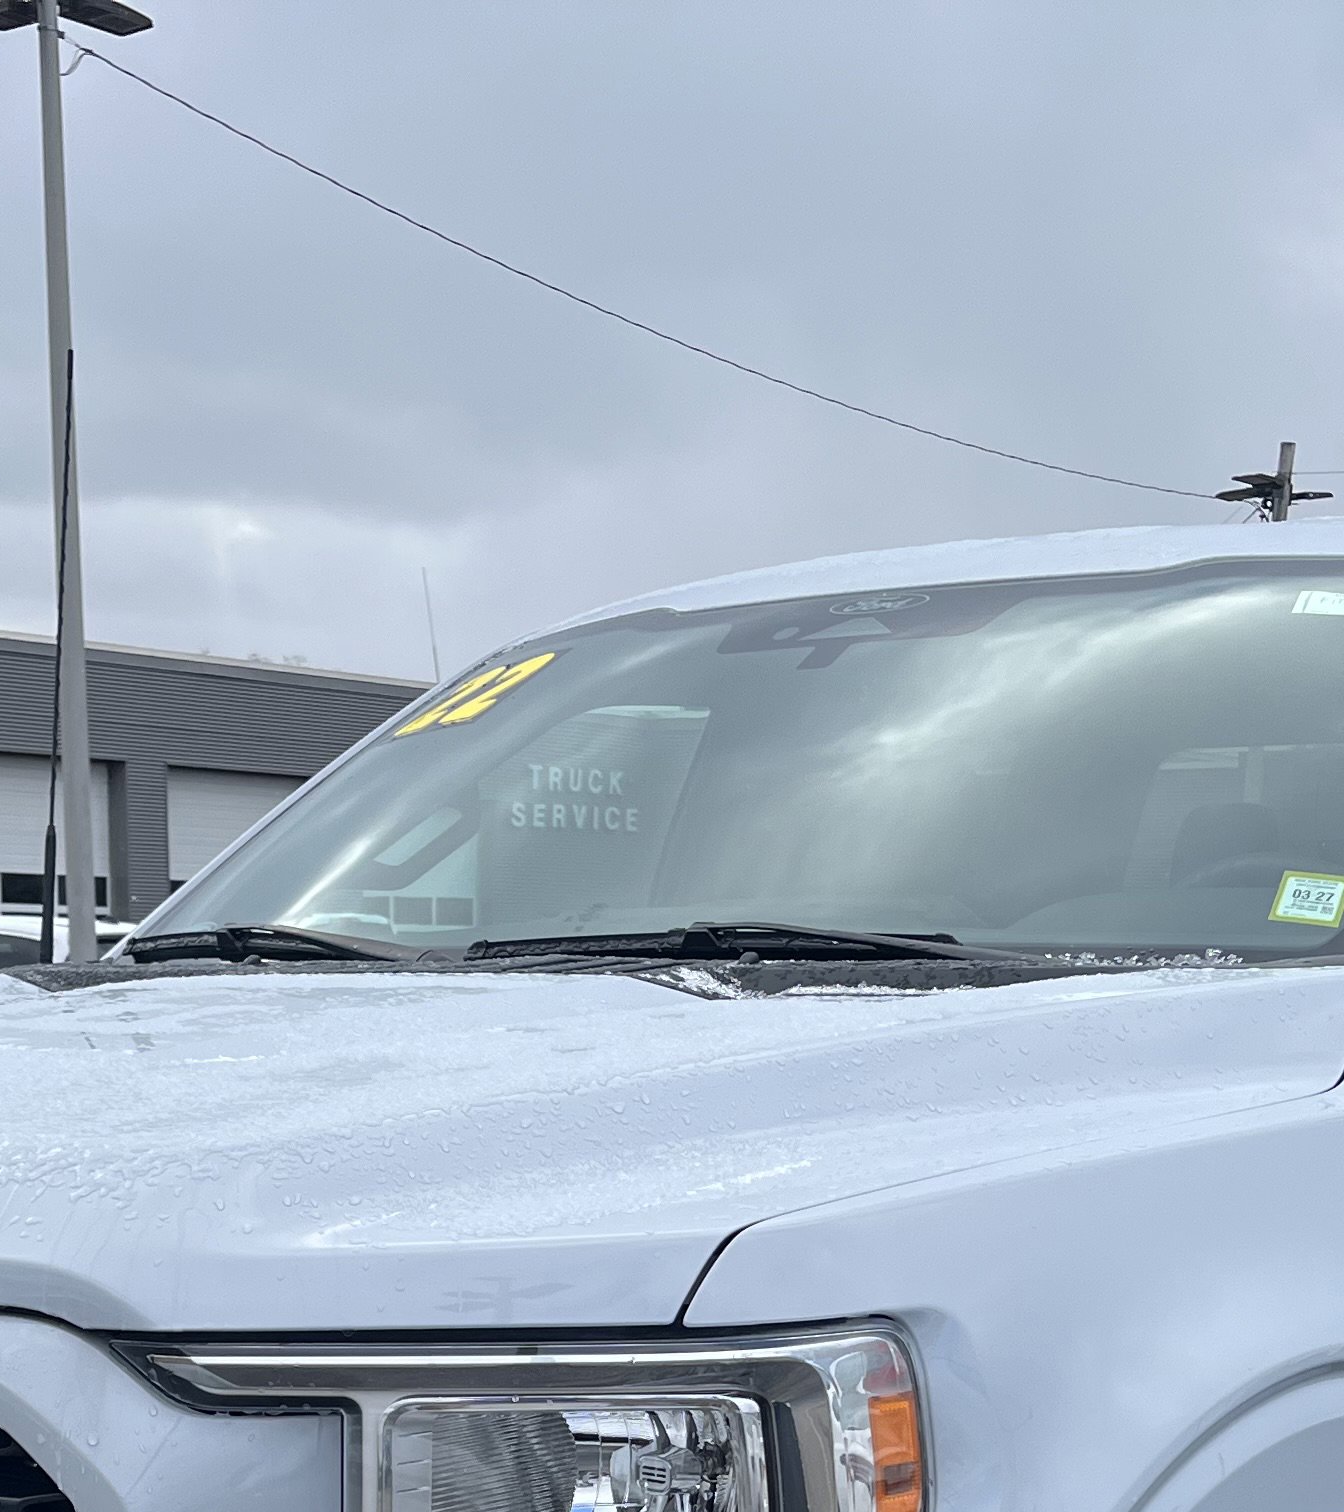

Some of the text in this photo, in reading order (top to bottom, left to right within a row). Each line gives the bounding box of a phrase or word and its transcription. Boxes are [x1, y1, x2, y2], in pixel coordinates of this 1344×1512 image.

[528, 763, 625, 796] TRUCK
[511, 801, 639, 832] SERVICE
[1291, 888, 1336, 902] 03 27
